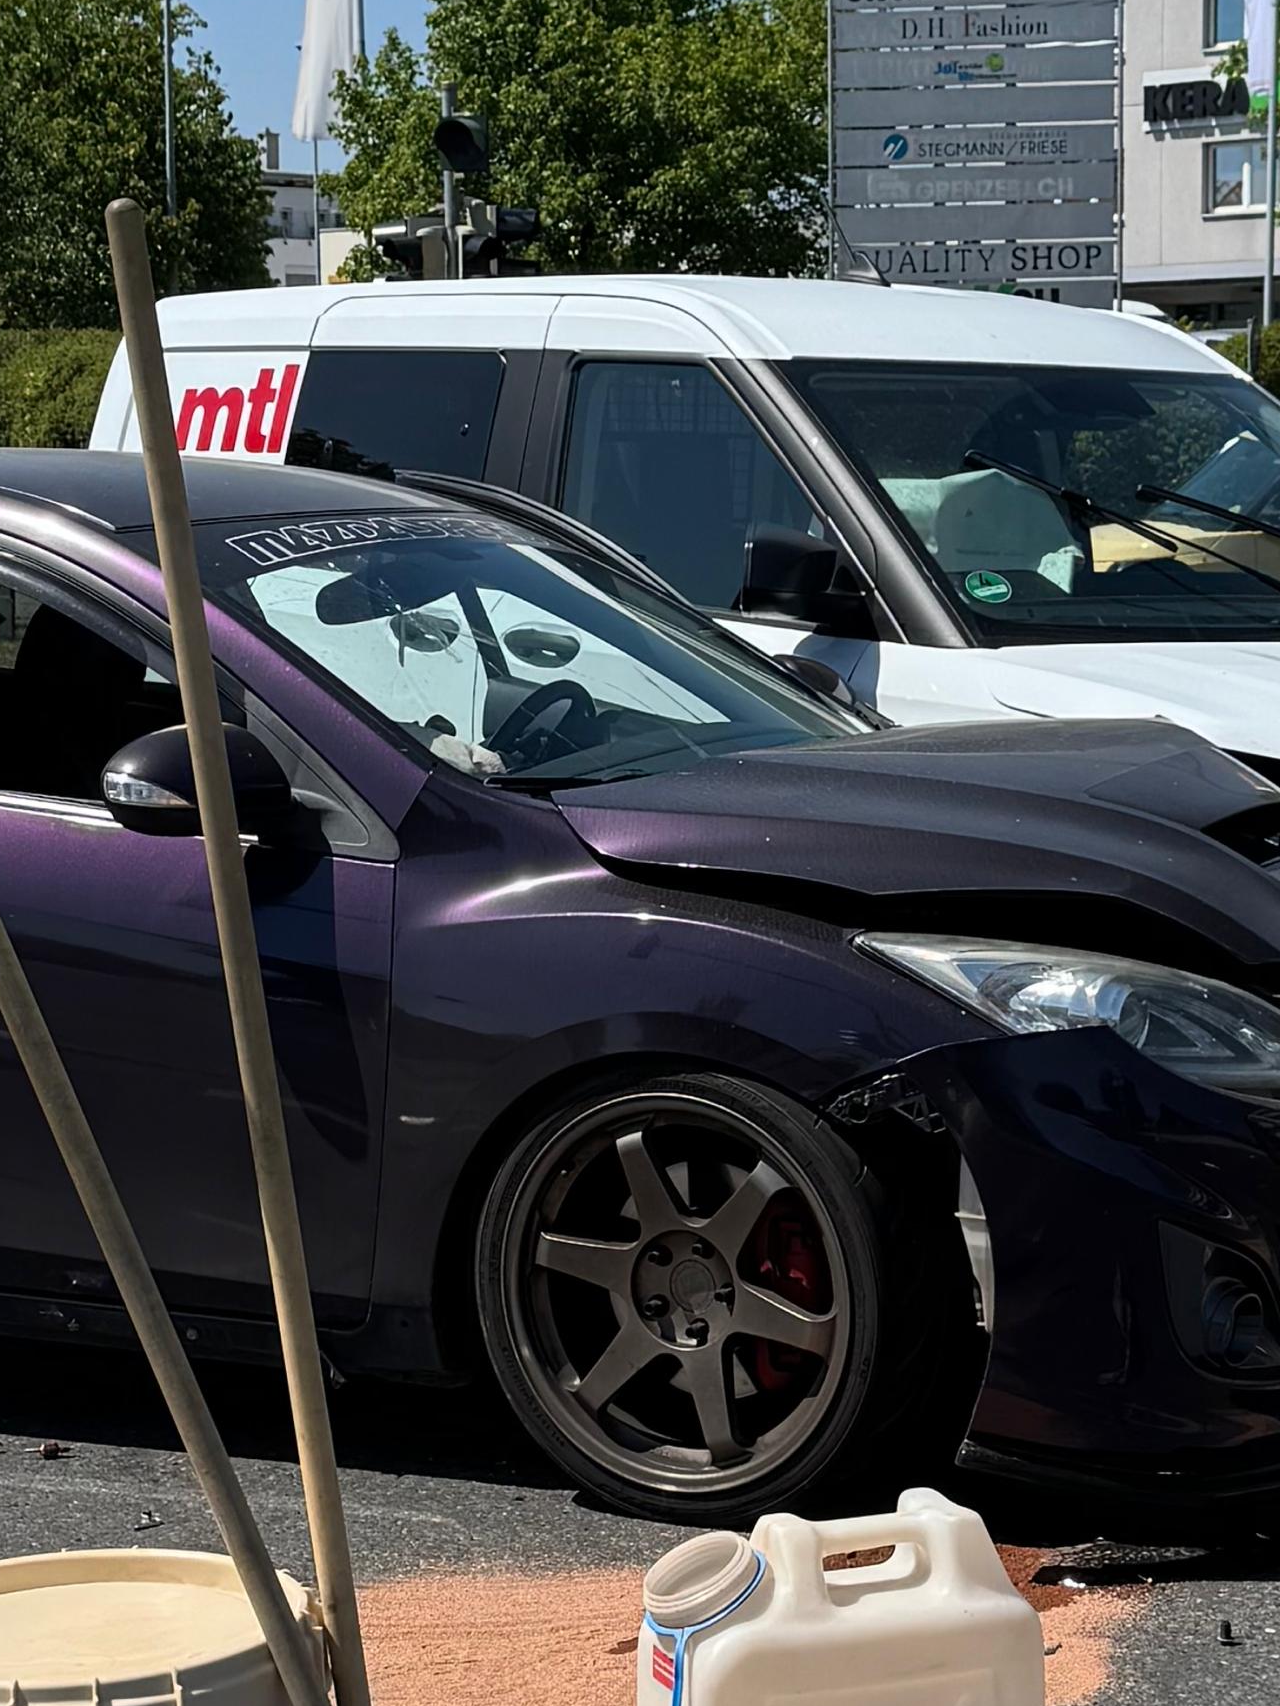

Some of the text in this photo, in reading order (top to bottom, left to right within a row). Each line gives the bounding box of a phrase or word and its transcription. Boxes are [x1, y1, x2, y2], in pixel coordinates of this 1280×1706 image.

[964, 12, 1049, 38] Fashion
[868, 244, 1102, 275] UALITY SHOP
[176, 364, 300, 453] mtl
